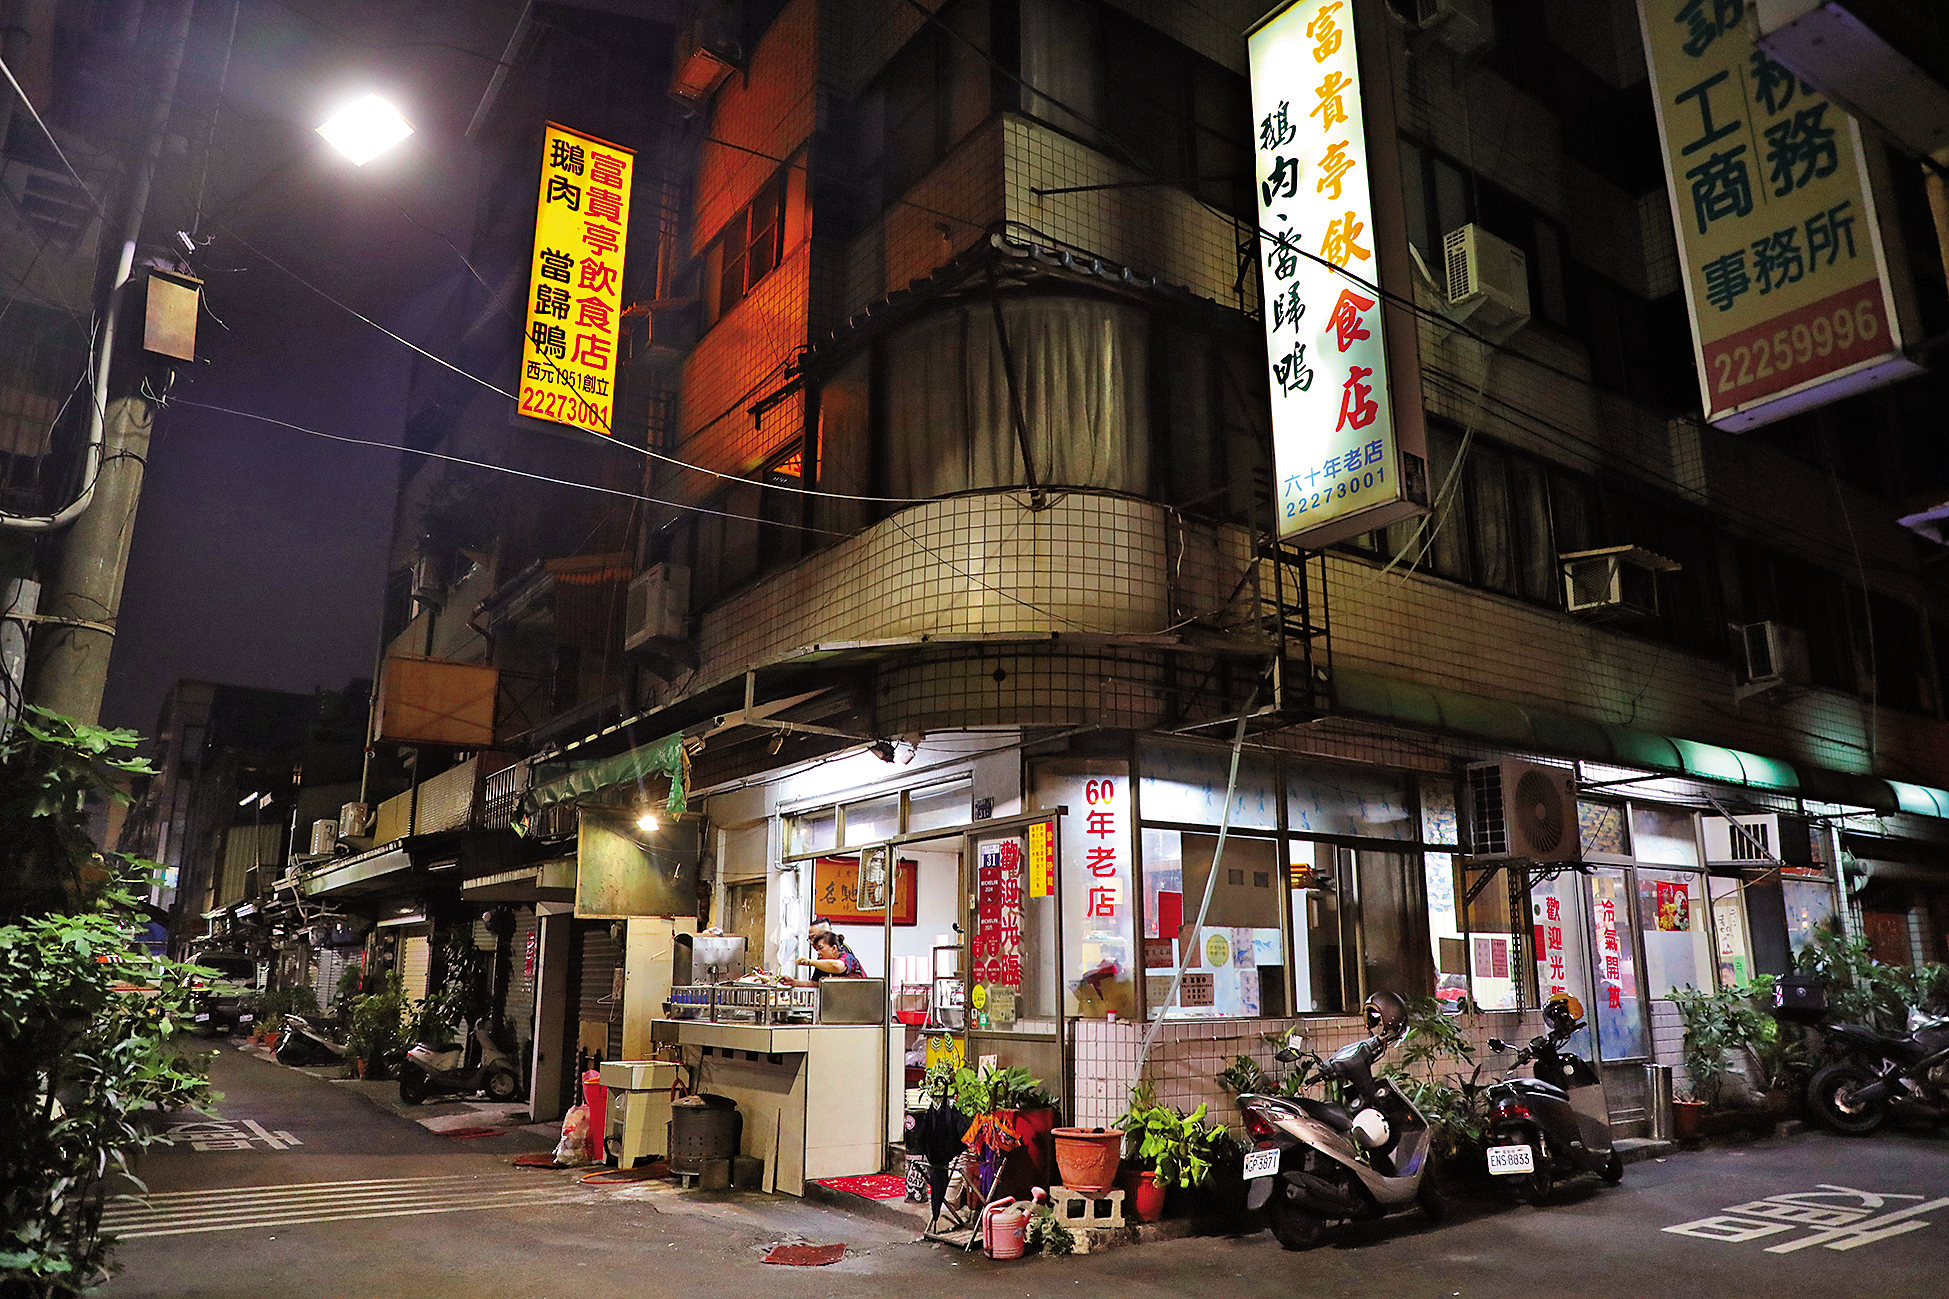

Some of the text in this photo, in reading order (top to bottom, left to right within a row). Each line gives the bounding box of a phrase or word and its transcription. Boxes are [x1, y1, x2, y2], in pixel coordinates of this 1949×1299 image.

[1305, 1, 1379, 433] 富貴亭飲食店
[571, 151, 627, 371] 富貴亭飲食店
[1702, 200, 1857, 312] 事務所
[527, 360, 609, 397] 西元1951創立
[1714, 300, 1878, 394] 22259996
[522, 387, 608, 429] 22273001
[1284, 439, 1384, 498] 六十年老店
[1286, 467, 1386, 518] 22273001
[986, 853, 997, 867] 31
[1000, 839, 1020, 985] 歡迎光臨
[1660, 1183, 1949, 1254] 慢
